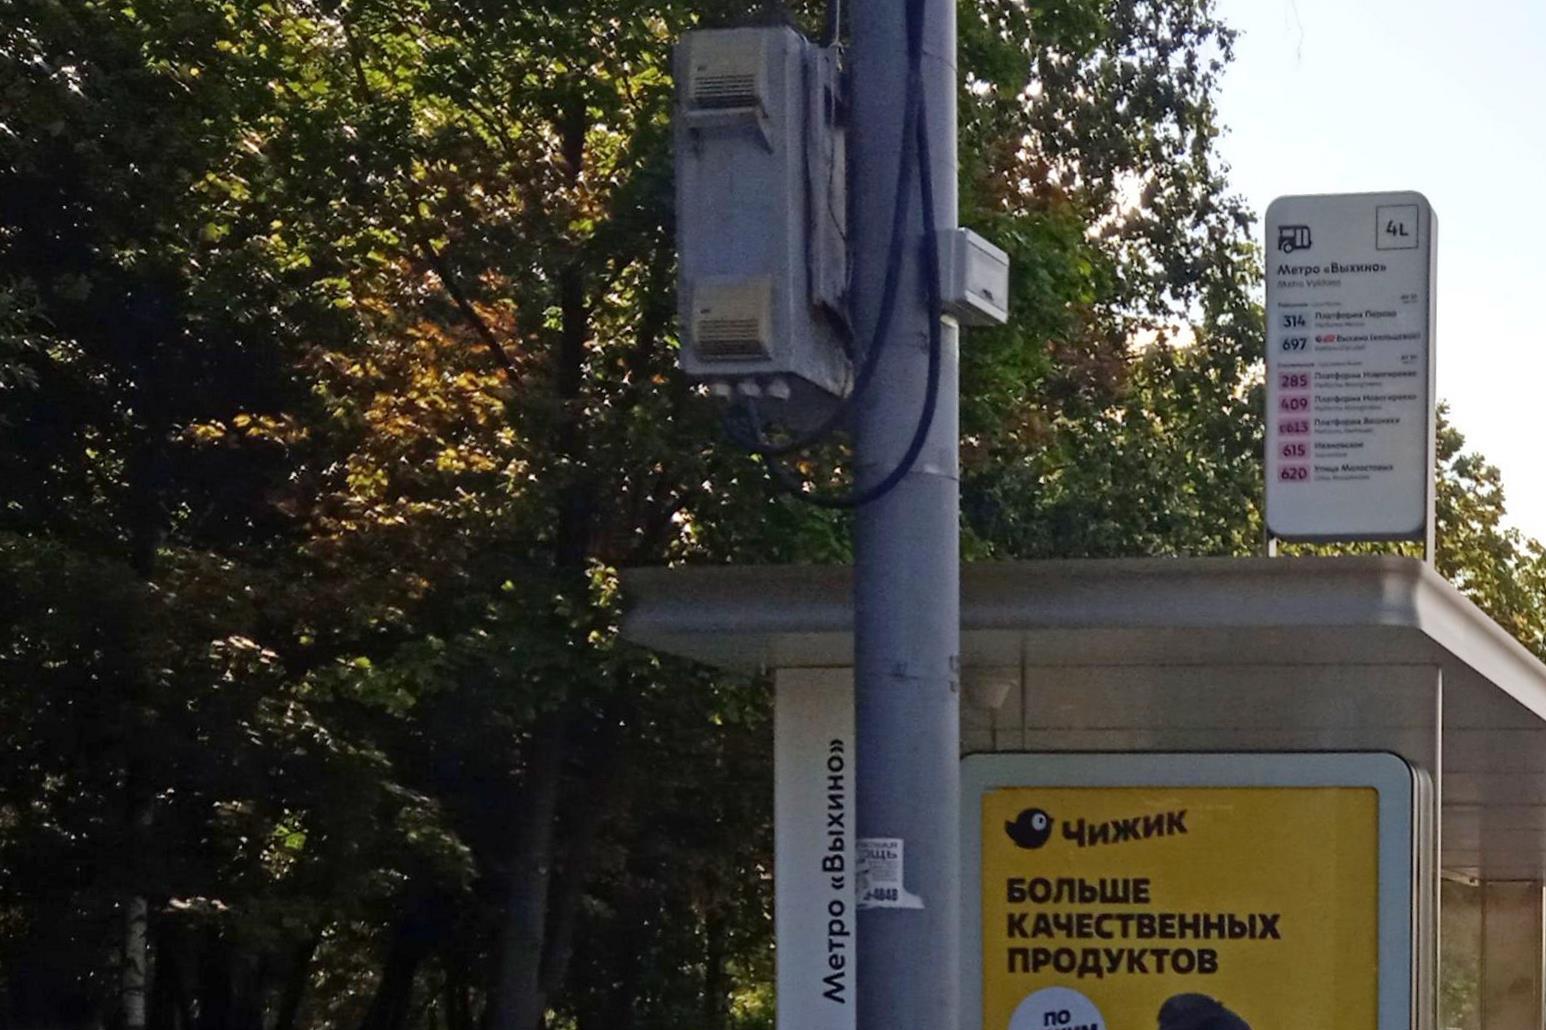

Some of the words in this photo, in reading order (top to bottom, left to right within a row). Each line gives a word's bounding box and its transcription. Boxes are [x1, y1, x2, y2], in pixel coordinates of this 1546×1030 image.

[1386, 220, 1408, 237] 4L
[1277, 264, 1320, 276] Метро
[1323, 262, 1387, 274] «Выхино»
[1283, 315, 1306, 328] 314
[1282, 338, 1307, 351] 697
[1282, 375, 1308, 388] 285
[1281, 398, 1308, 412] 409
[1283, 444, 1306, 457] 615
[1281, 468, 1307, 481] 620
[822, 738, 846, 889] «Выхино»
[1007, 877, 1151, 904] БОЛЬШЕ
[1007, 912, 1281, 940] КАЧЕСТВЕННЫХ
[822, 901, 851, 1004] Метро
[1007, 948, 1219, 979] ПРОДУКТОВ
[1043, 1010, 1071, 1027] ПО
